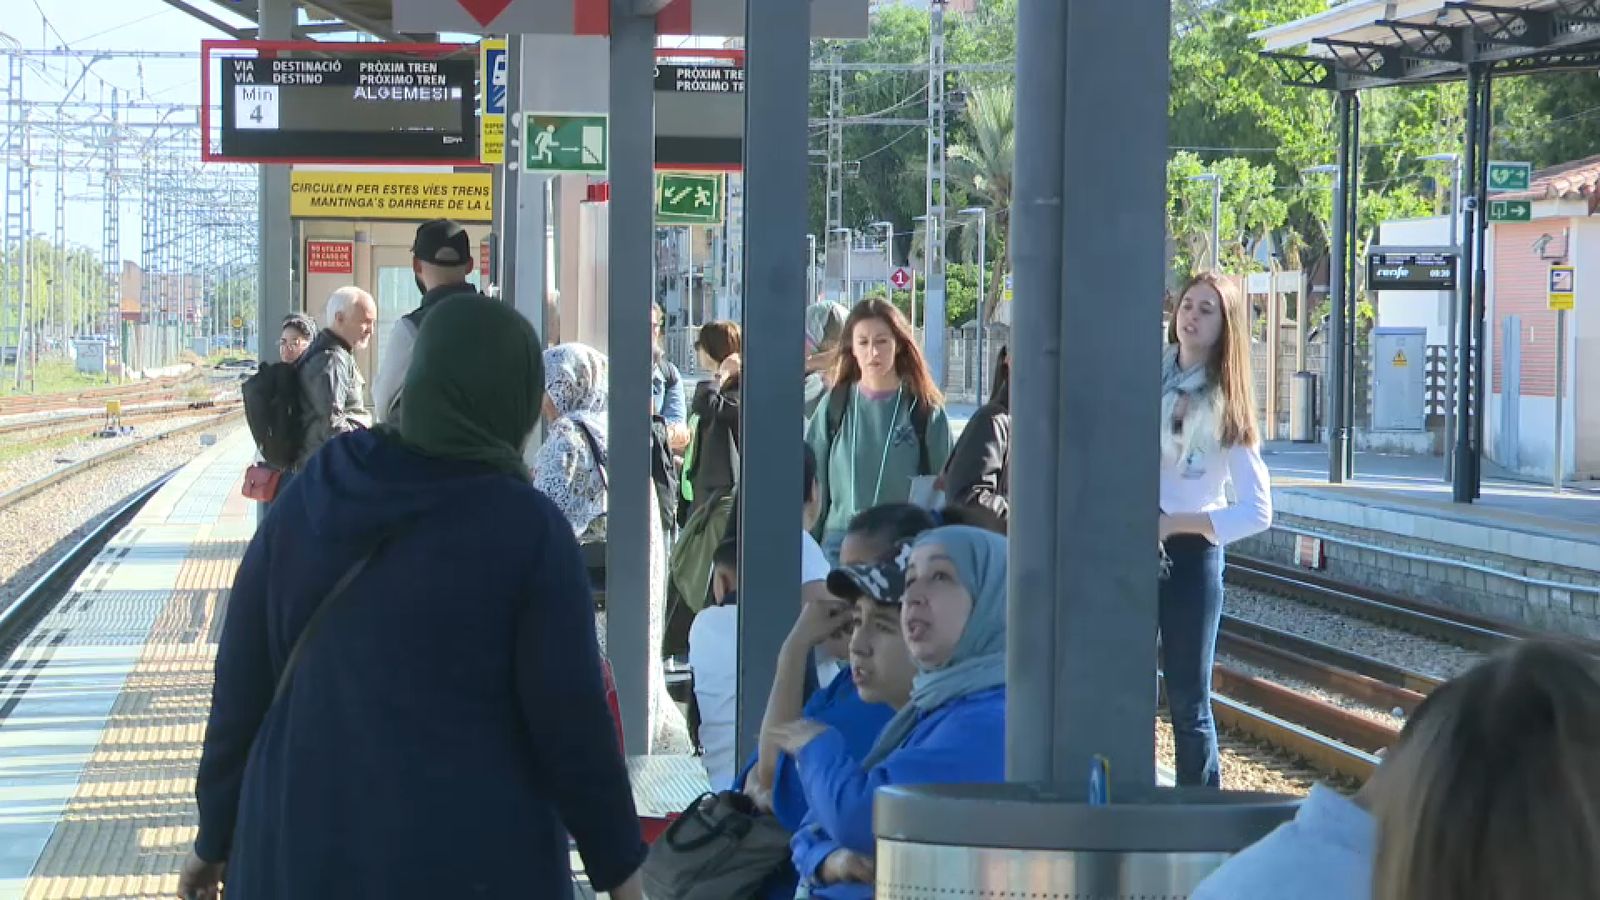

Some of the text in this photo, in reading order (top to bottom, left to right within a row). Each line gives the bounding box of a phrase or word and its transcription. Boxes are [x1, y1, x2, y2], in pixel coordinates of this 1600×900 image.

[234, 60, 254, 71] VIA
[272, 60, 342, 72] DESTINACIÓ
[359, 60, 438, 73] PRÒXIM TREN
[272, 73, 323, 84] DESTINO
[359, 72, 446, 84] PRÓXIMO TREN
[723, 69, 744, 79] TRE
[676, 78, 729, 91] PRÓXIMO
[243, 87, 273, 101] Min
[249, 104, 264, 124] 4
[291, 182, 353, 194] CIRCULEN
[356, 184, 379, 195] PER
[383, 184, 419, 196] ESTES
[452, 186, 489, 197] TRENS
[311, 197, 384, 208] MANTINGA'S
[388, 199, 445, 209] DARRERE
[448, 199, 464, 210] DE
[467, 200, 481, 211] LA
[896, 271, 904, 284] 1
